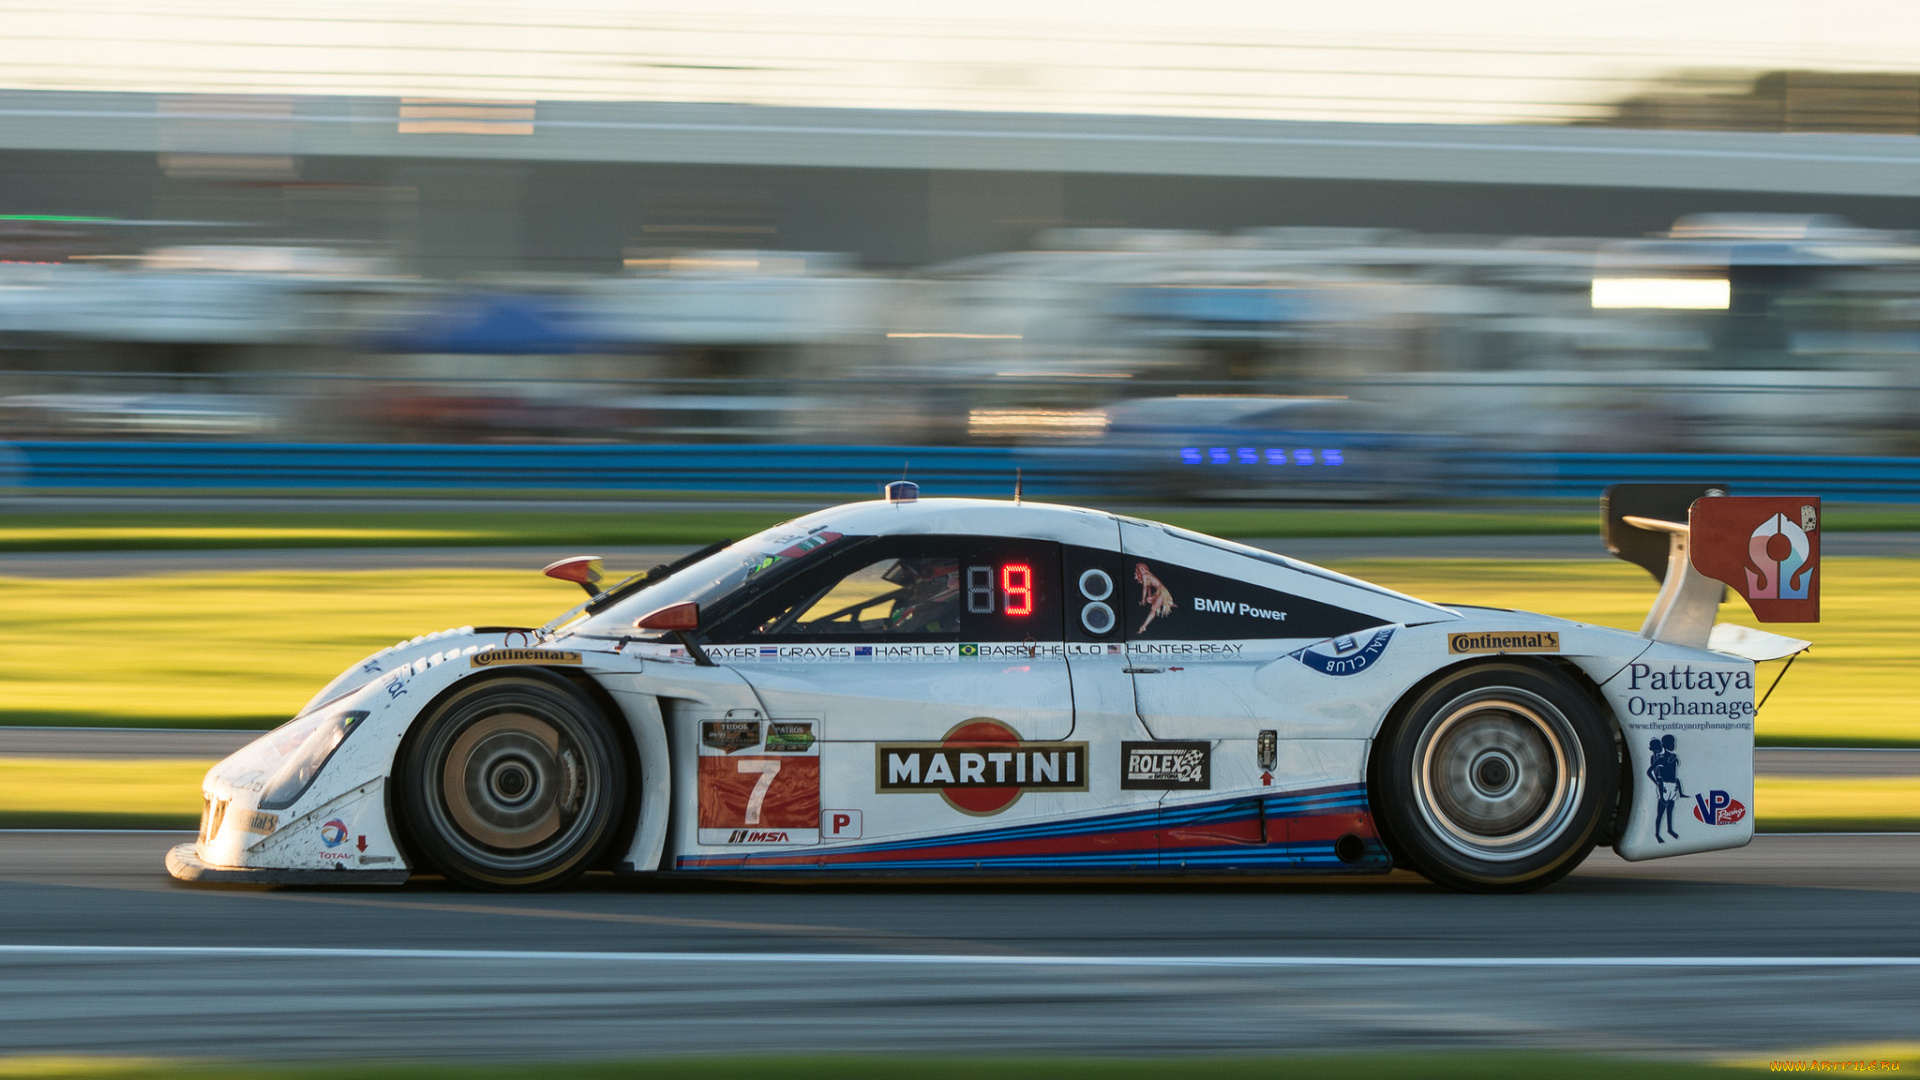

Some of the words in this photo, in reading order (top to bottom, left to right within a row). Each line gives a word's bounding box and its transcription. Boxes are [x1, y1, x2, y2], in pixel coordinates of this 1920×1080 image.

[1003, 563, 1032, 615] 9
[1194, 597, 1236, 615] BMW
[1239, 602, 1287, 621] Power
[779, 647, 850, 657] GRAVES
[875, 645, 955, 656] HARTLEY
[1127, 643, 1243, 655] HUNTER-REAY
[1452, 634, 1543, 653] Continental
[473, 649, 563, 666] Continental
[1326, 655, 1366, 672] CLUB
[1628, 663, 1753, 697] Pattaya
[1628, 696, 1753, 720] Orphanage
[1628, 721, 1751, 731] www.thepattayaorphanage.org
[888, 752, 1076, 784] MARTINI
[1129, 755, 1184, 773] ROLEX
[1178, 765, 1202, 782] 24
[737, 760, 781, 825] 7
[1695, 790, 1730, 825] VP
[833, 814, 851, 834] P
[748, 832, 789, 842] IMSA
[318, 851, 351, 859] TOTAL
